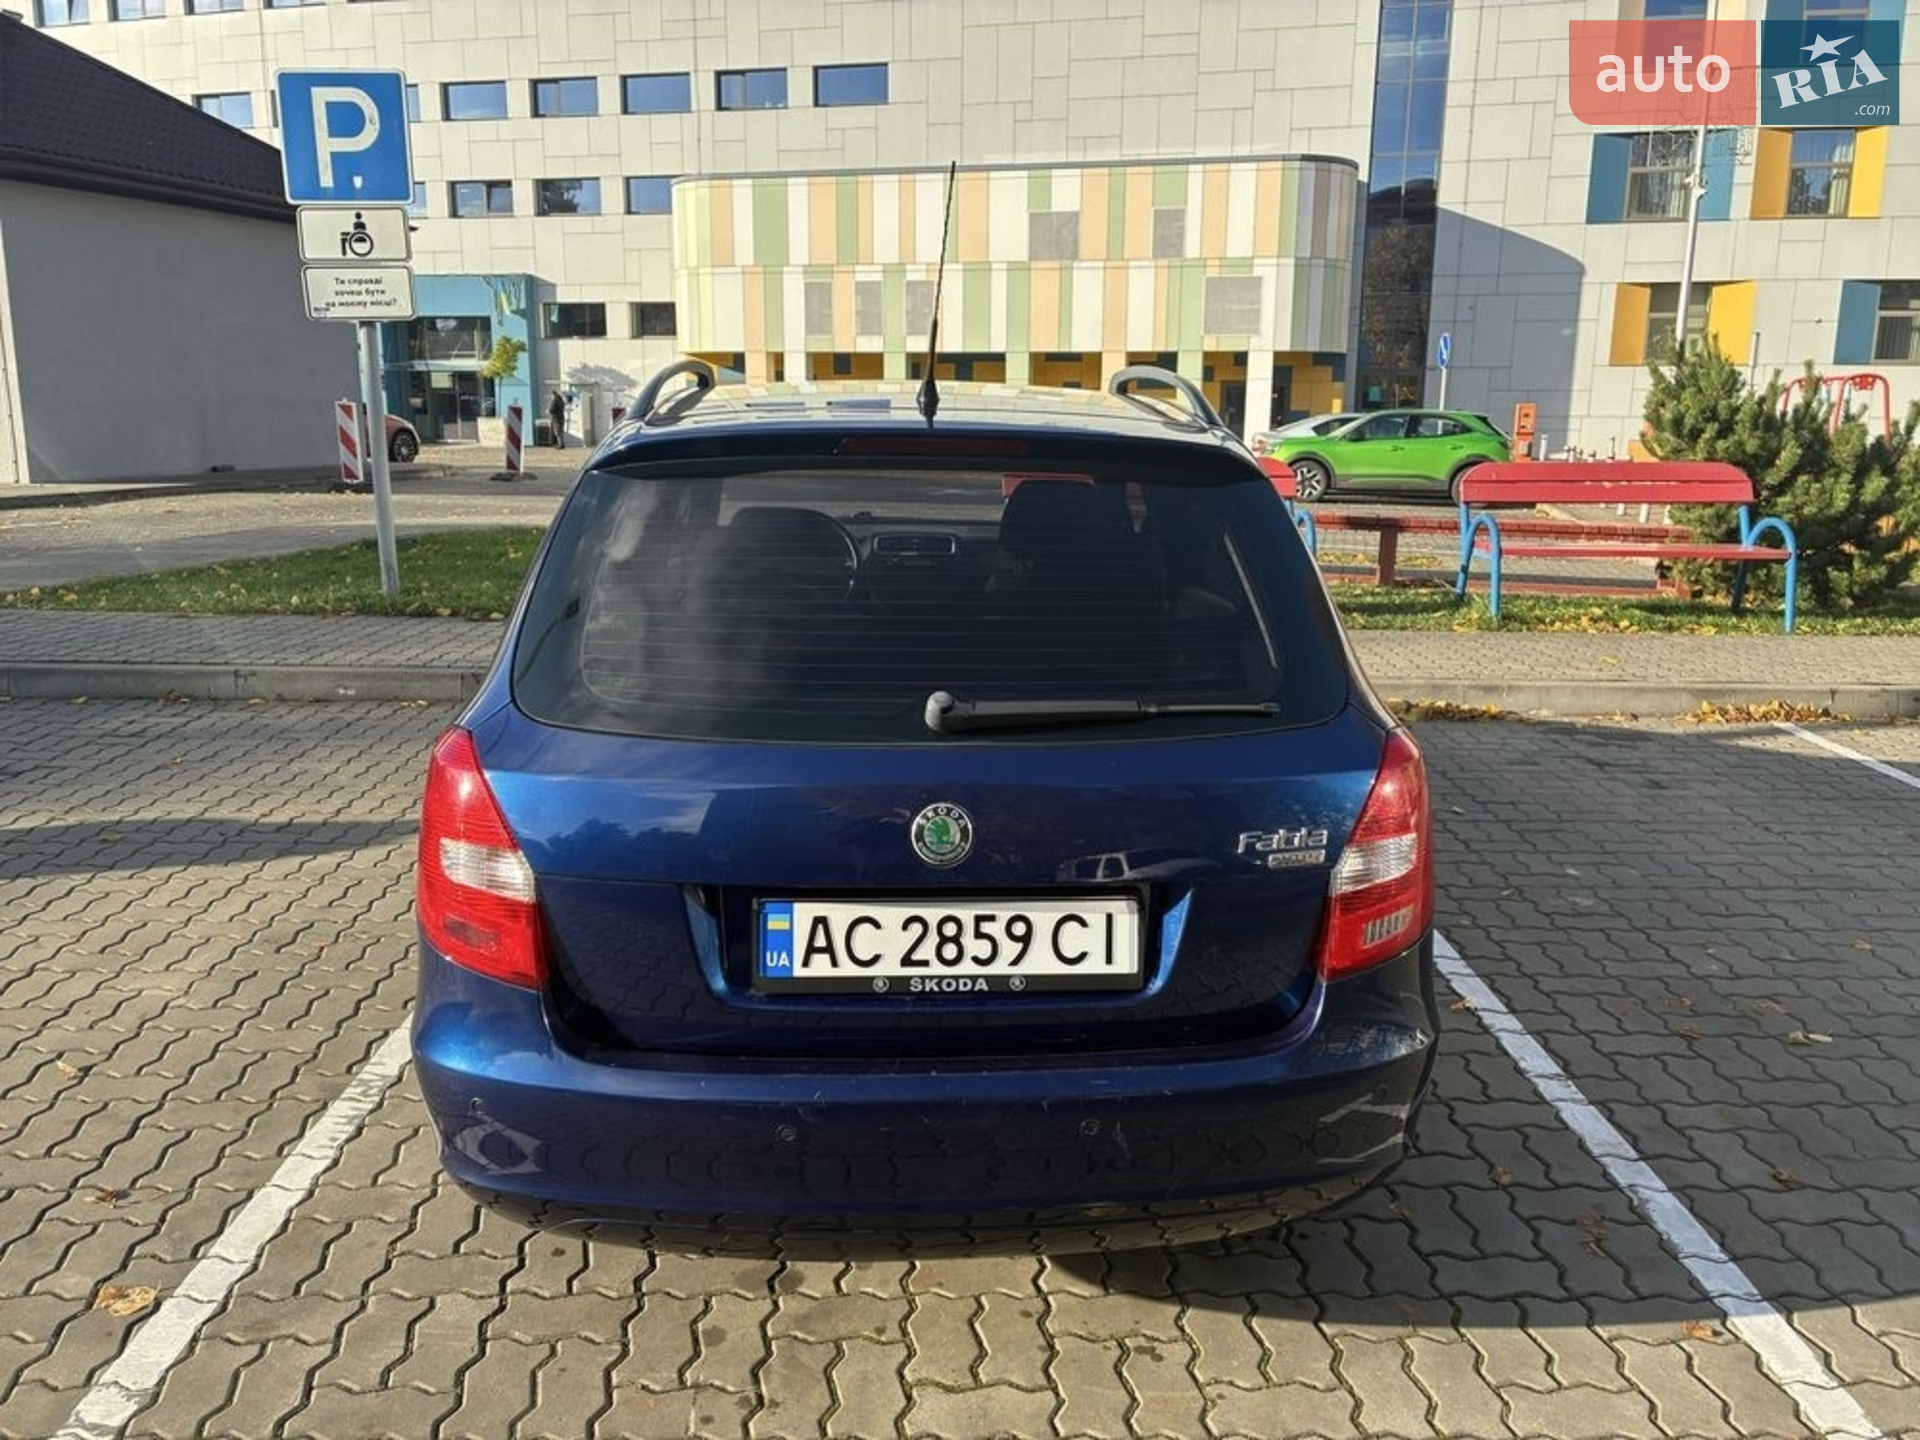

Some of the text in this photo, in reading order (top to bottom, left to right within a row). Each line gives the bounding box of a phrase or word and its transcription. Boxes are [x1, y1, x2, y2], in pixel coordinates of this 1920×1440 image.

[310, 86, 381, 189] P
[334, 275, 383, 286] Ти справді
[364, 287, 386, 297] бути
[1237, 827, 1329, 854] Fabia
[801, 912, 1114, 968] AC 2859 CI
[766, 951, 790, 967] UA
